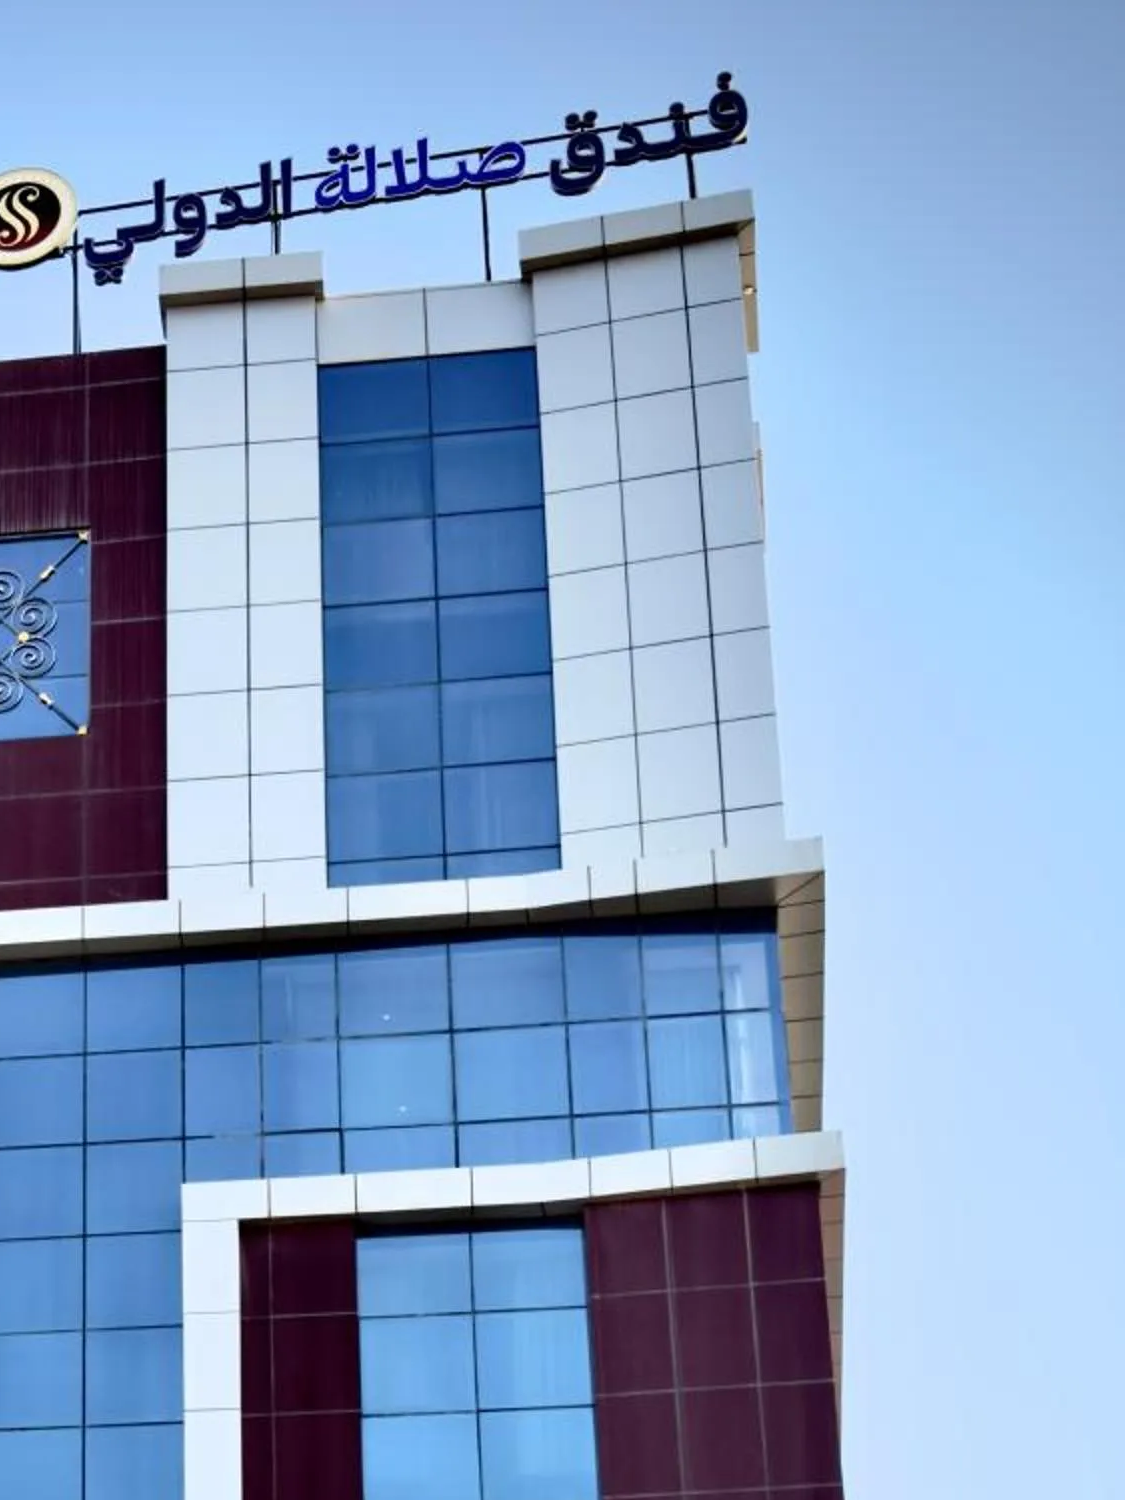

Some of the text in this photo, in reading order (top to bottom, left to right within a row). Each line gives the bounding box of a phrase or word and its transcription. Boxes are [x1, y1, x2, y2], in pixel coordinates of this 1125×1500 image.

[83, 72, 750, 286] فندق صلالة الدولي
